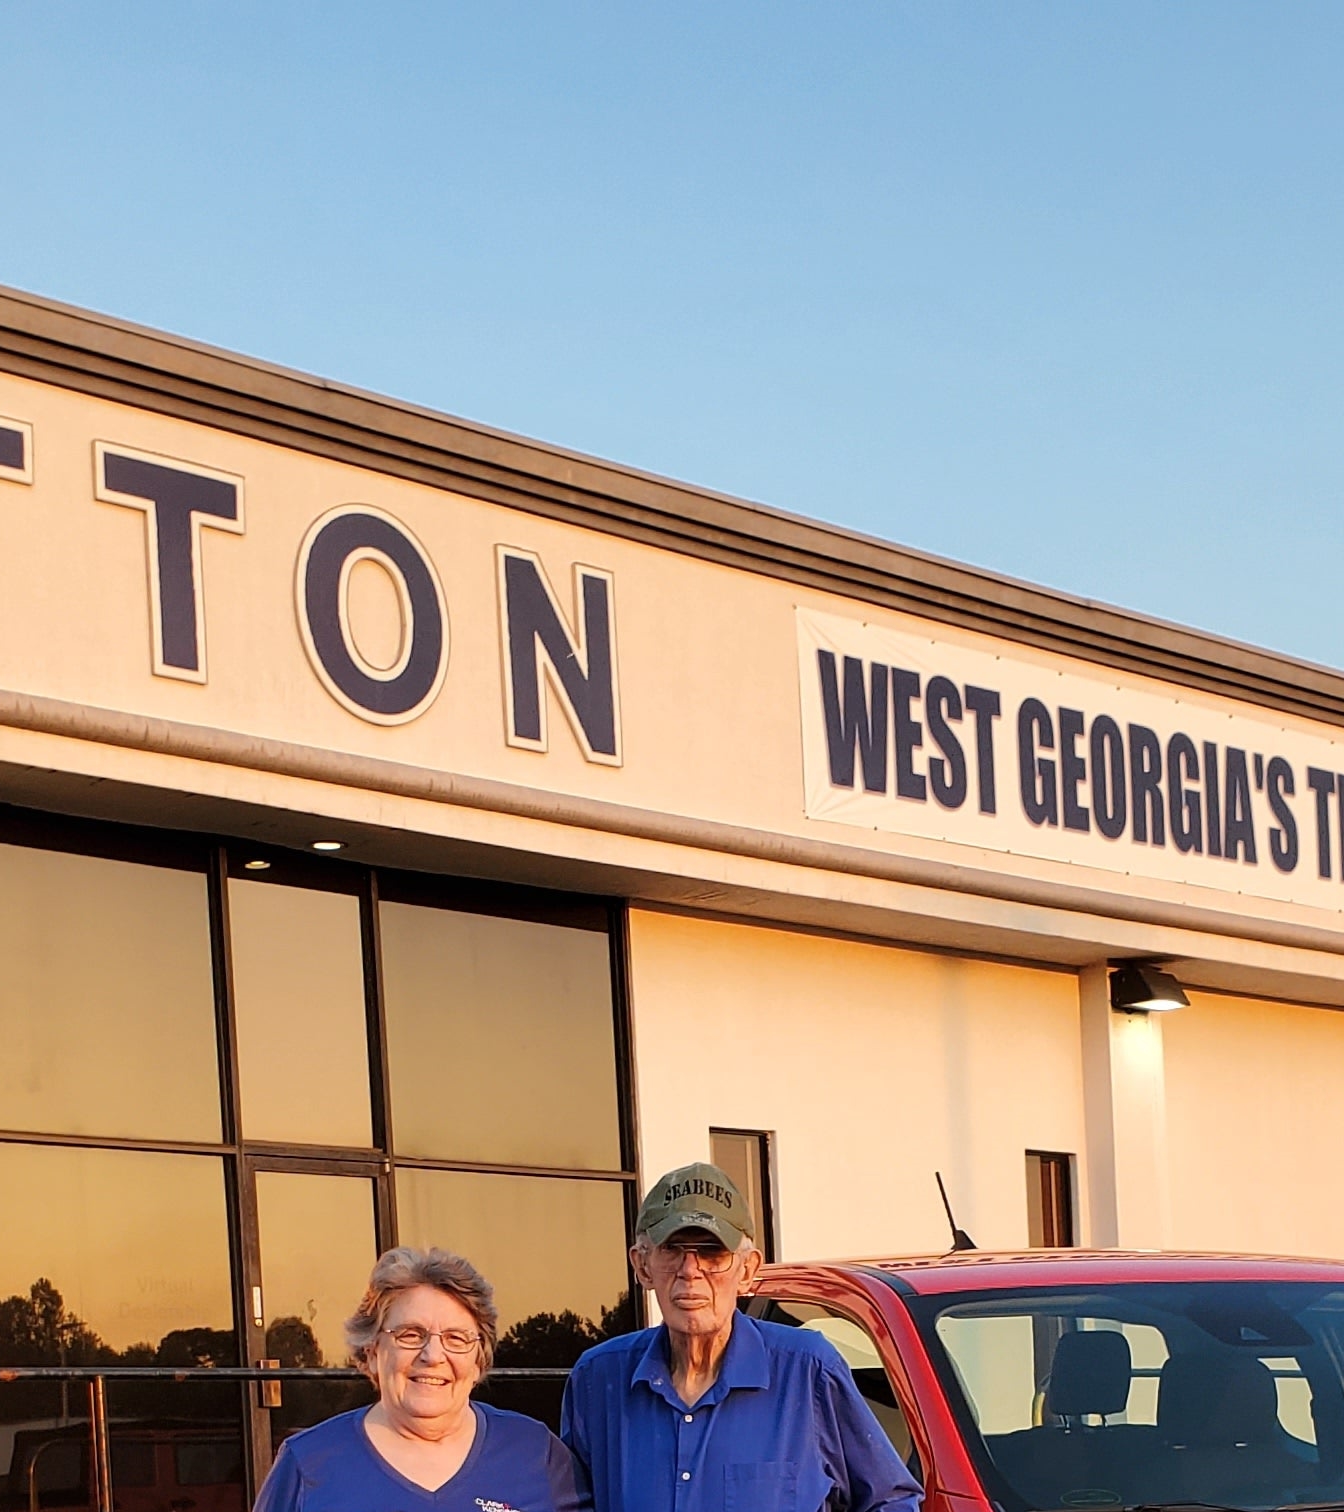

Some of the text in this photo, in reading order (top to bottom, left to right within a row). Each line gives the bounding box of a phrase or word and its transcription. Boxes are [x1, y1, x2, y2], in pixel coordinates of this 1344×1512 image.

[817, 648, 1001, 815] WEST
[1017, 696, 1299, 873] GEORGIA'S
[664, 1178, 732, 1209] SEABEES
